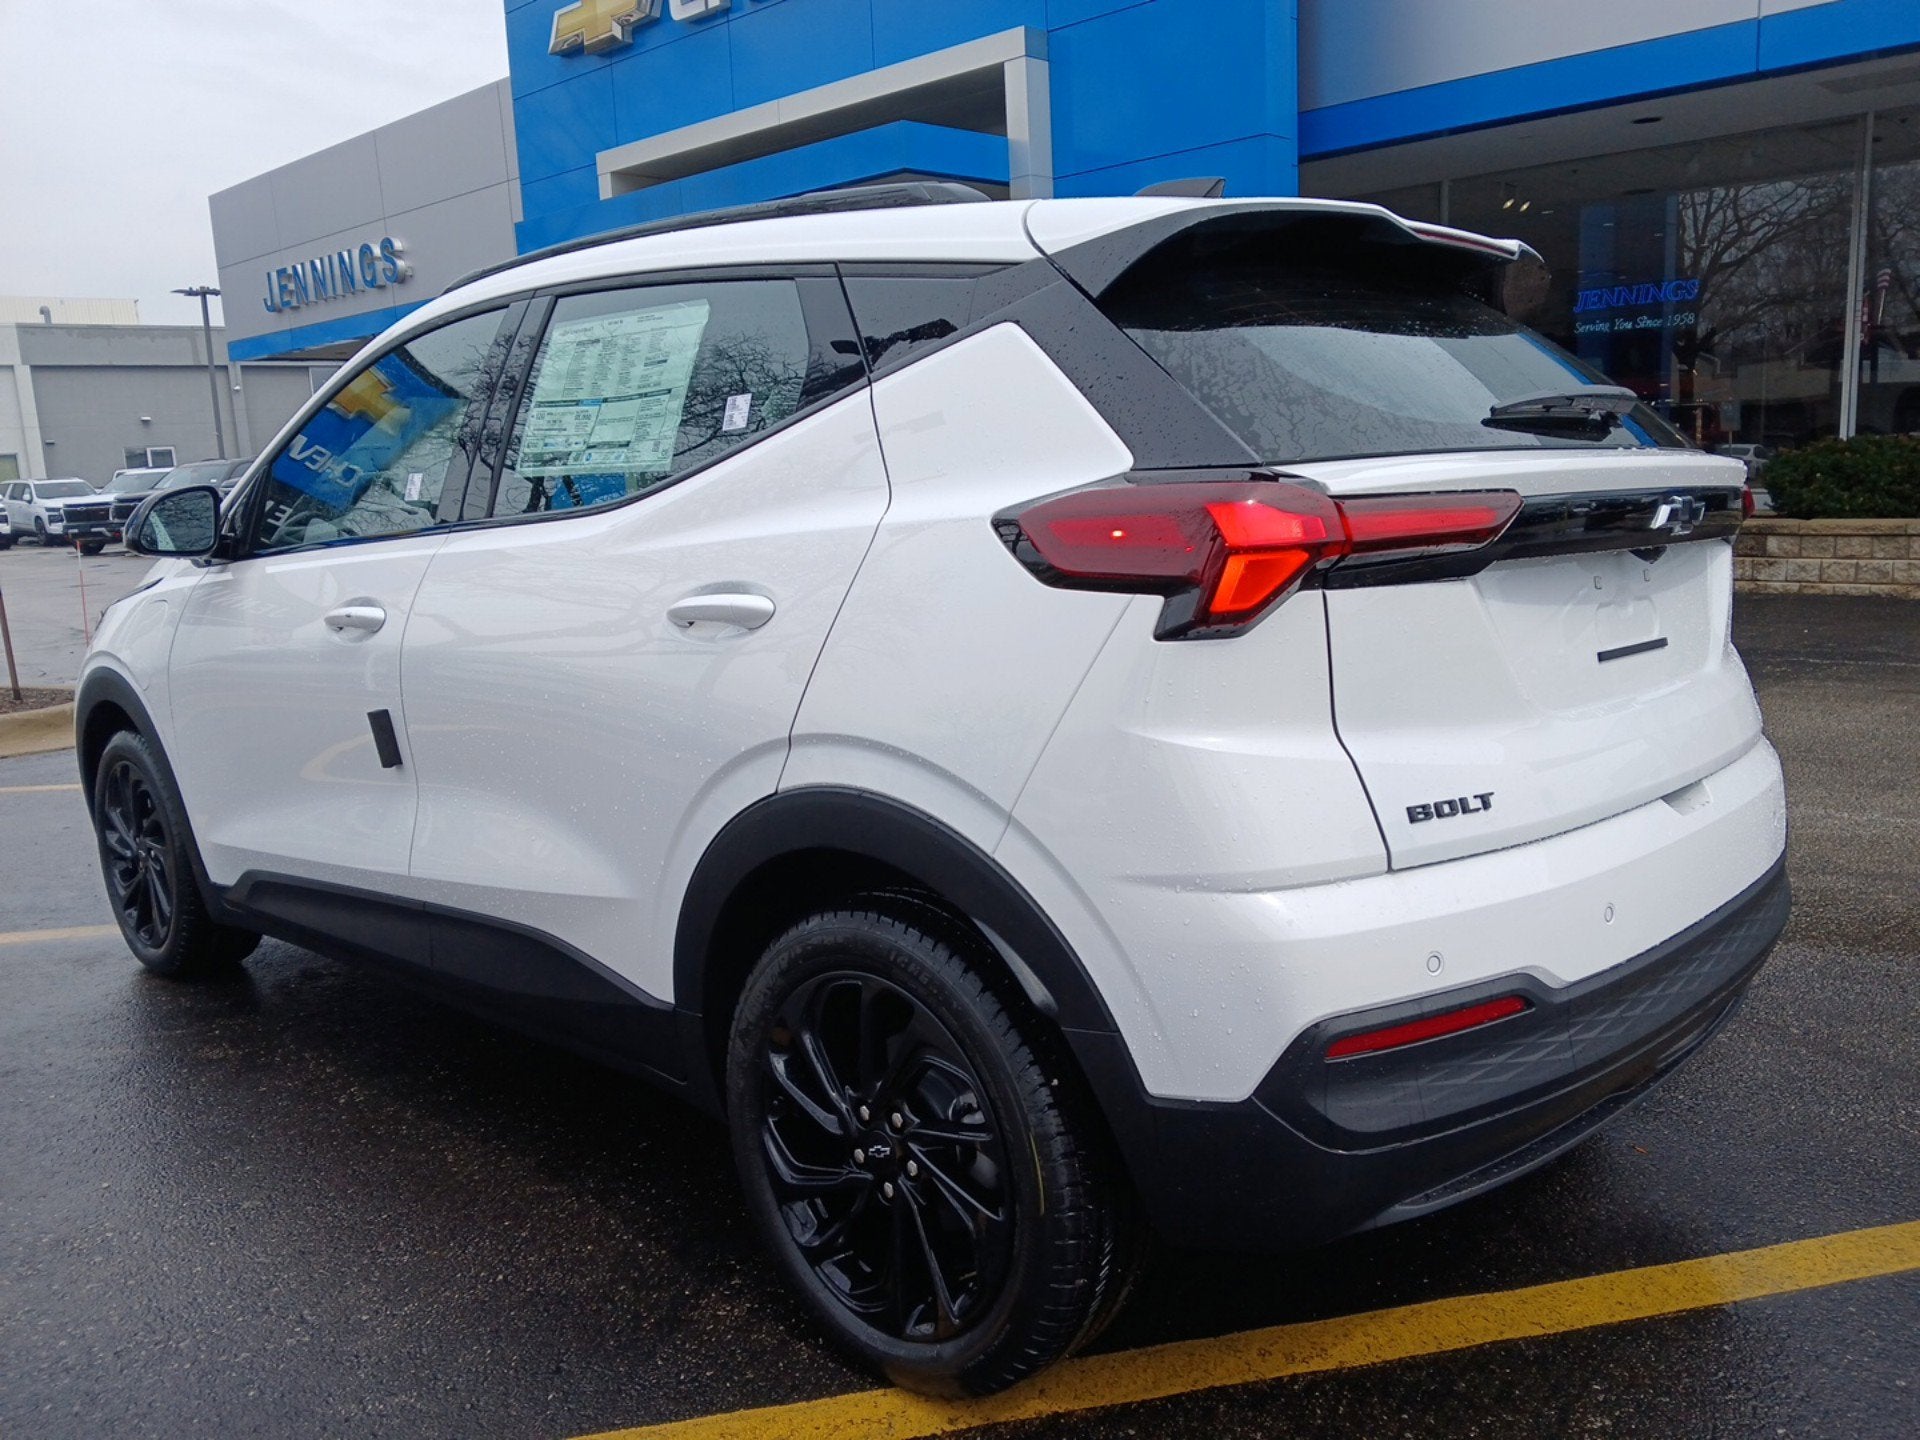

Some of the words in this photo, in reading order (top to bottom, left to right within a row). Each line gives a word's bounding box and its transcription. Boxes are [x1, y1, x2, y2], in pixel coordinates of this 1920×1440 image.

[263, 237, 406, 312] JENNINGS
[1573, 280, 1700, 314] JENNINGS
[1574, 320, 1610, 334] Serving
[1614, 318, 1633, 330] You
[1635, 315, 1664, 329] Since
[1667, 312, 1696, 327] 1958
[1406, 791, 1496, 824] BOLT
